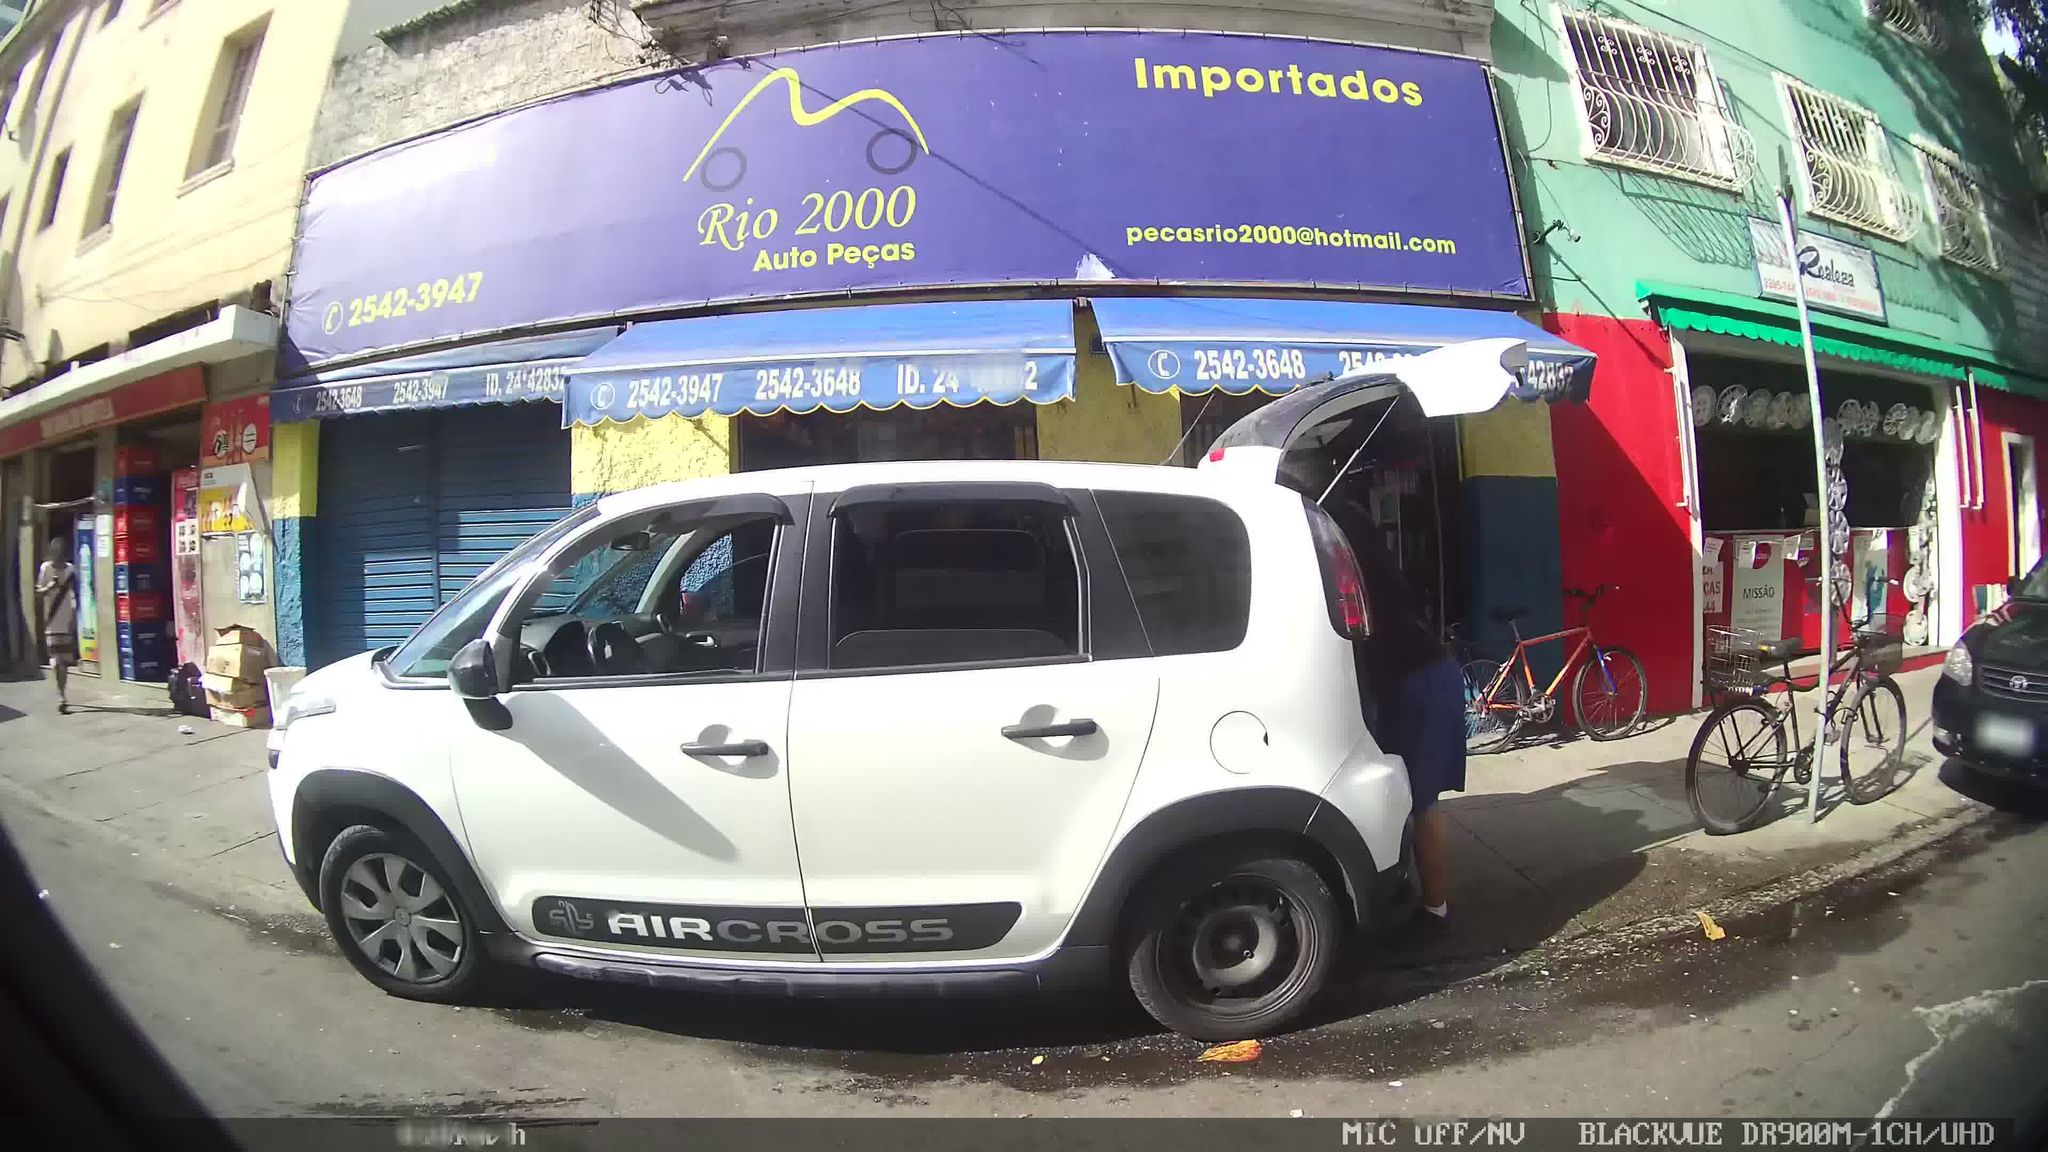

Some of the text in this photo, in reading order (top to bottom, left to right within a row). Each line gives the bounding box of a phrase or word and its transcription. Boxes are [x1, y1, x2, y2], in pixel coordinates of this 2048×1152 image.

[1134, 57, 1424, 107] Importados
[697, 185, 917, 251] Rio 2000
[752, 242, 916, 272] Auto Peças
[1126, 224, 1457, 255] pecasrio2000@hotmail.com
[1797, 245, 1856, 287] Realeza
[348, 271, 484, 326] 2542-3947
[1194, 349, 1307, 381] 2542-3648
[316, 385, 363, 411] 2542-3648
[393, 376, 448, 404] 2542-3947
[485, 372, 502, 397] ID.
[627, 373, 724, 409] 2542-3947
[755, 367, 862, 401] 2542-3648
[1742, 585, 1775, 600] MISSÃO
[608, 911, 954, 944] AIRCROSS
